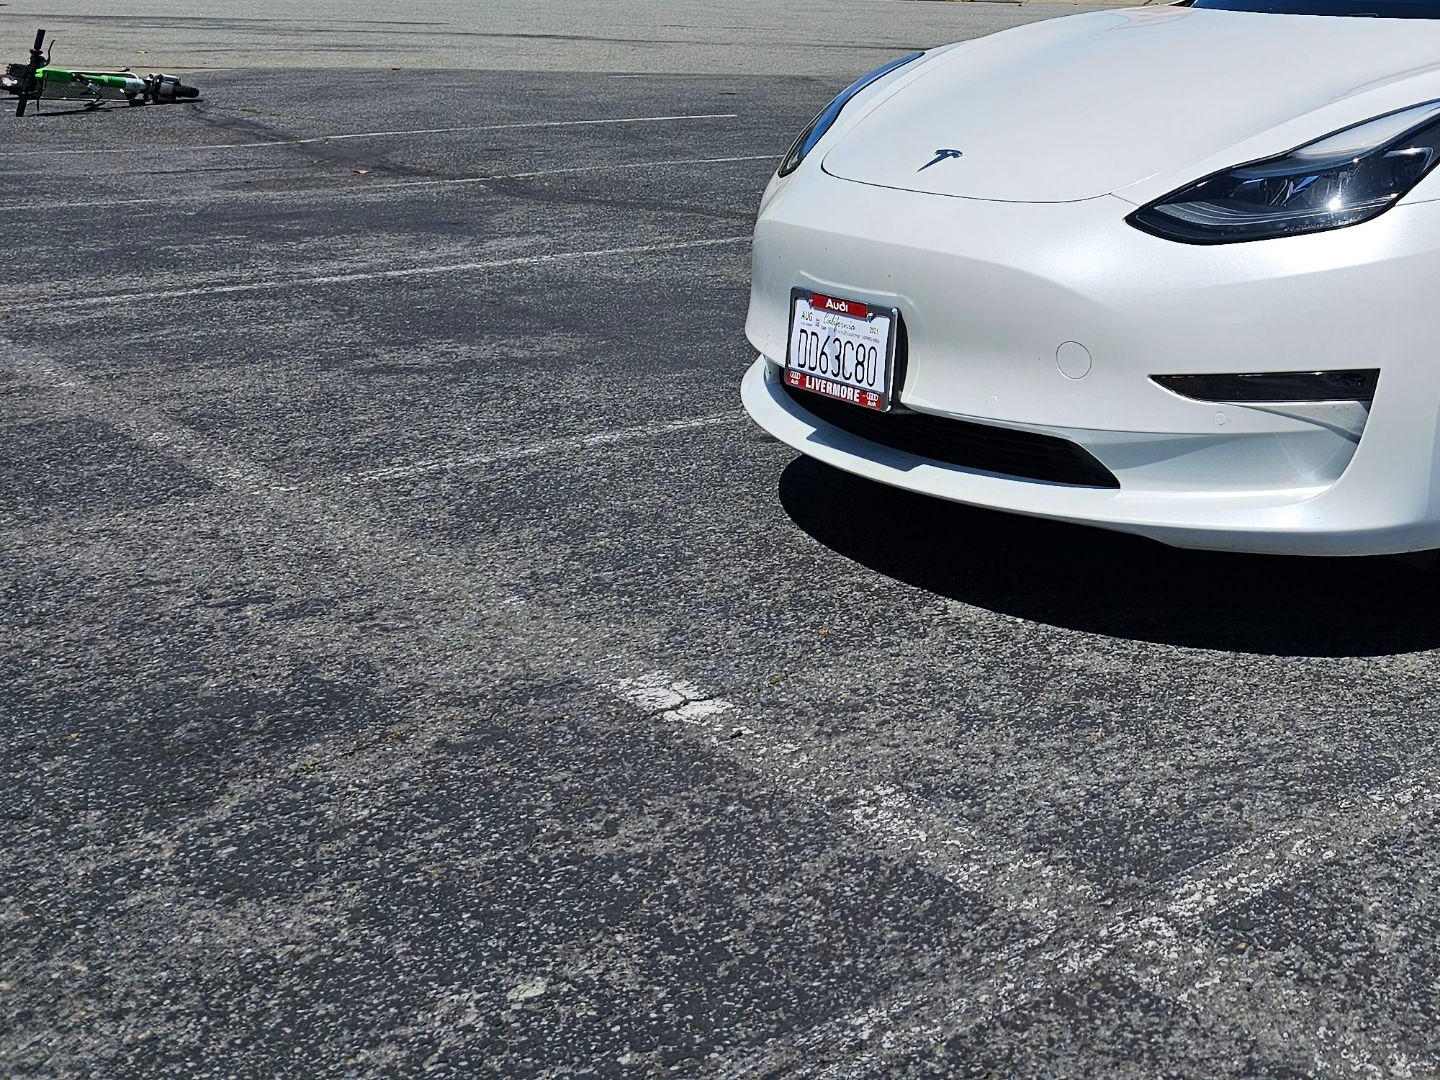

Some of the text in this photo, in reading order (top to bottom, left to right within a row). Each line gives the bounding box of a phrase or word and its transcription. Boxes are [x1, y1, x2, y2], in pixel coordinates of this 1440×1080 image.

[825, 298, 848, 313] Audi
[798, 329, 877, 387] DD63C80
[805, 375, 861, 403] LIVERMORE
